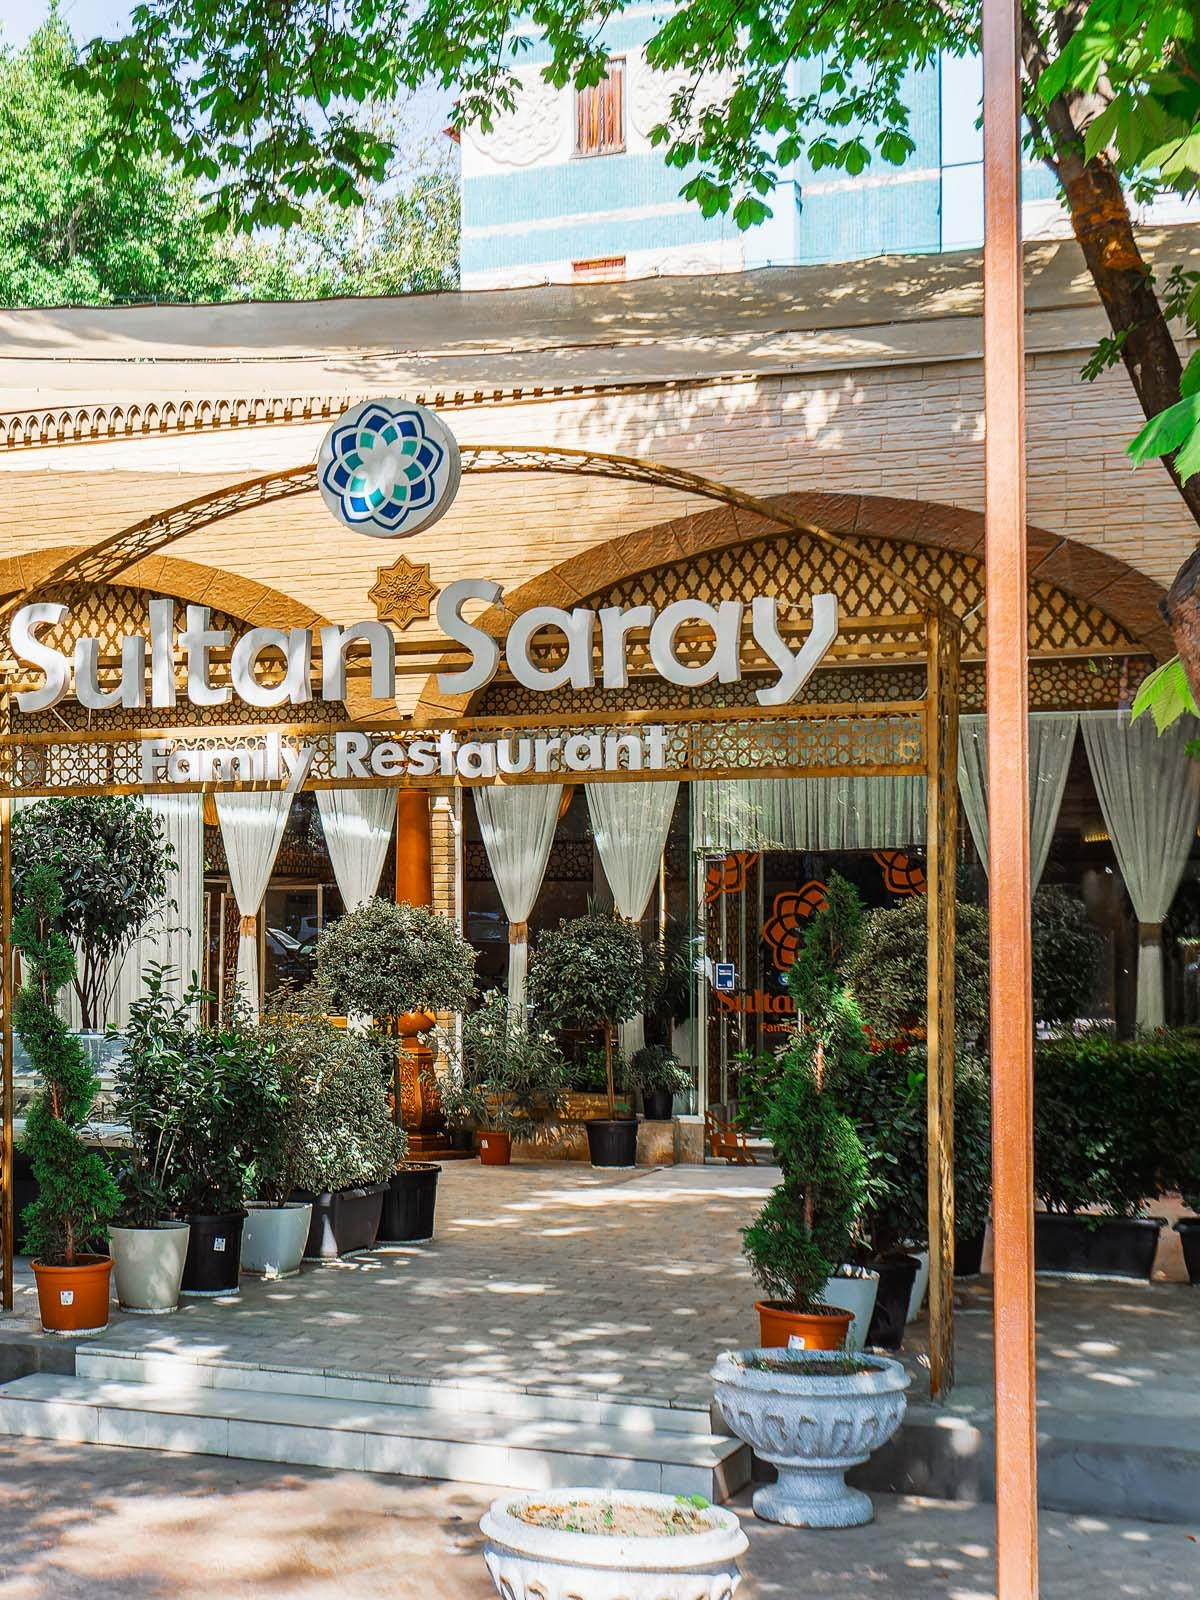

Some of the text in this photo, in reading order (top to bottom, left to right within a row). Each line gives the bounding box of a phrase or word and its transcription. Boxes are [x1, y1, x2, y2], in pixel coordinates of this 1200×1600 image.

[10, 578, 838, 713] Sultan Saray
[141, 725, 668, 793] Family Restaurant
[715, 987, 797, 1014] Sulta
